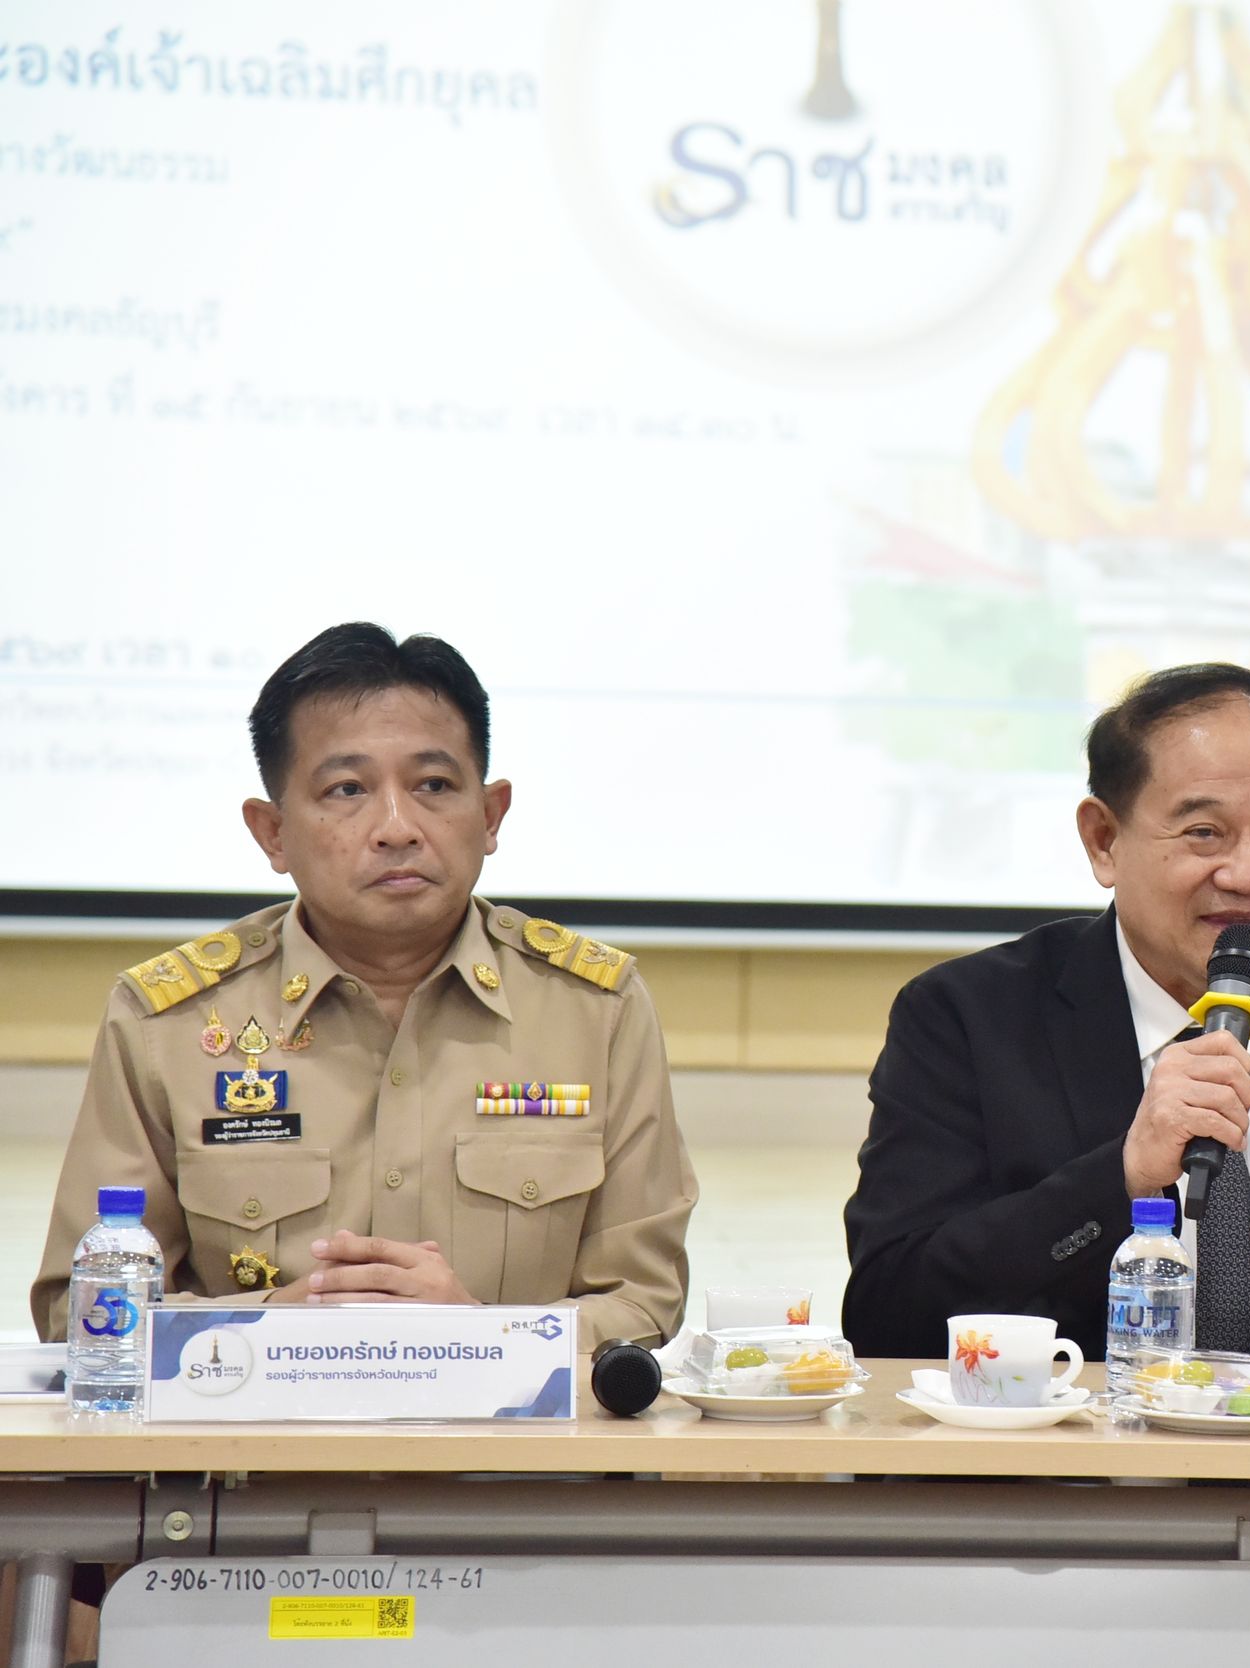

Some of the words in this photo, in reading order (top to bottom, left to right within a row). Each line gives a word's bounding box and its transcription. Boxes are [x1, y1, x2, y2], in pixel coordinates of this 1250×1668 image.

[1143, 1328, 1180, 1339] WATER
[266, 1340, 398, 1361] นายองครักษ์
[402, 1342, 504, 1361] ทองนิรมล
[265, 1368, 438, 1384] รองผู้ว่าราชการจังหวัดปทุมธานี
